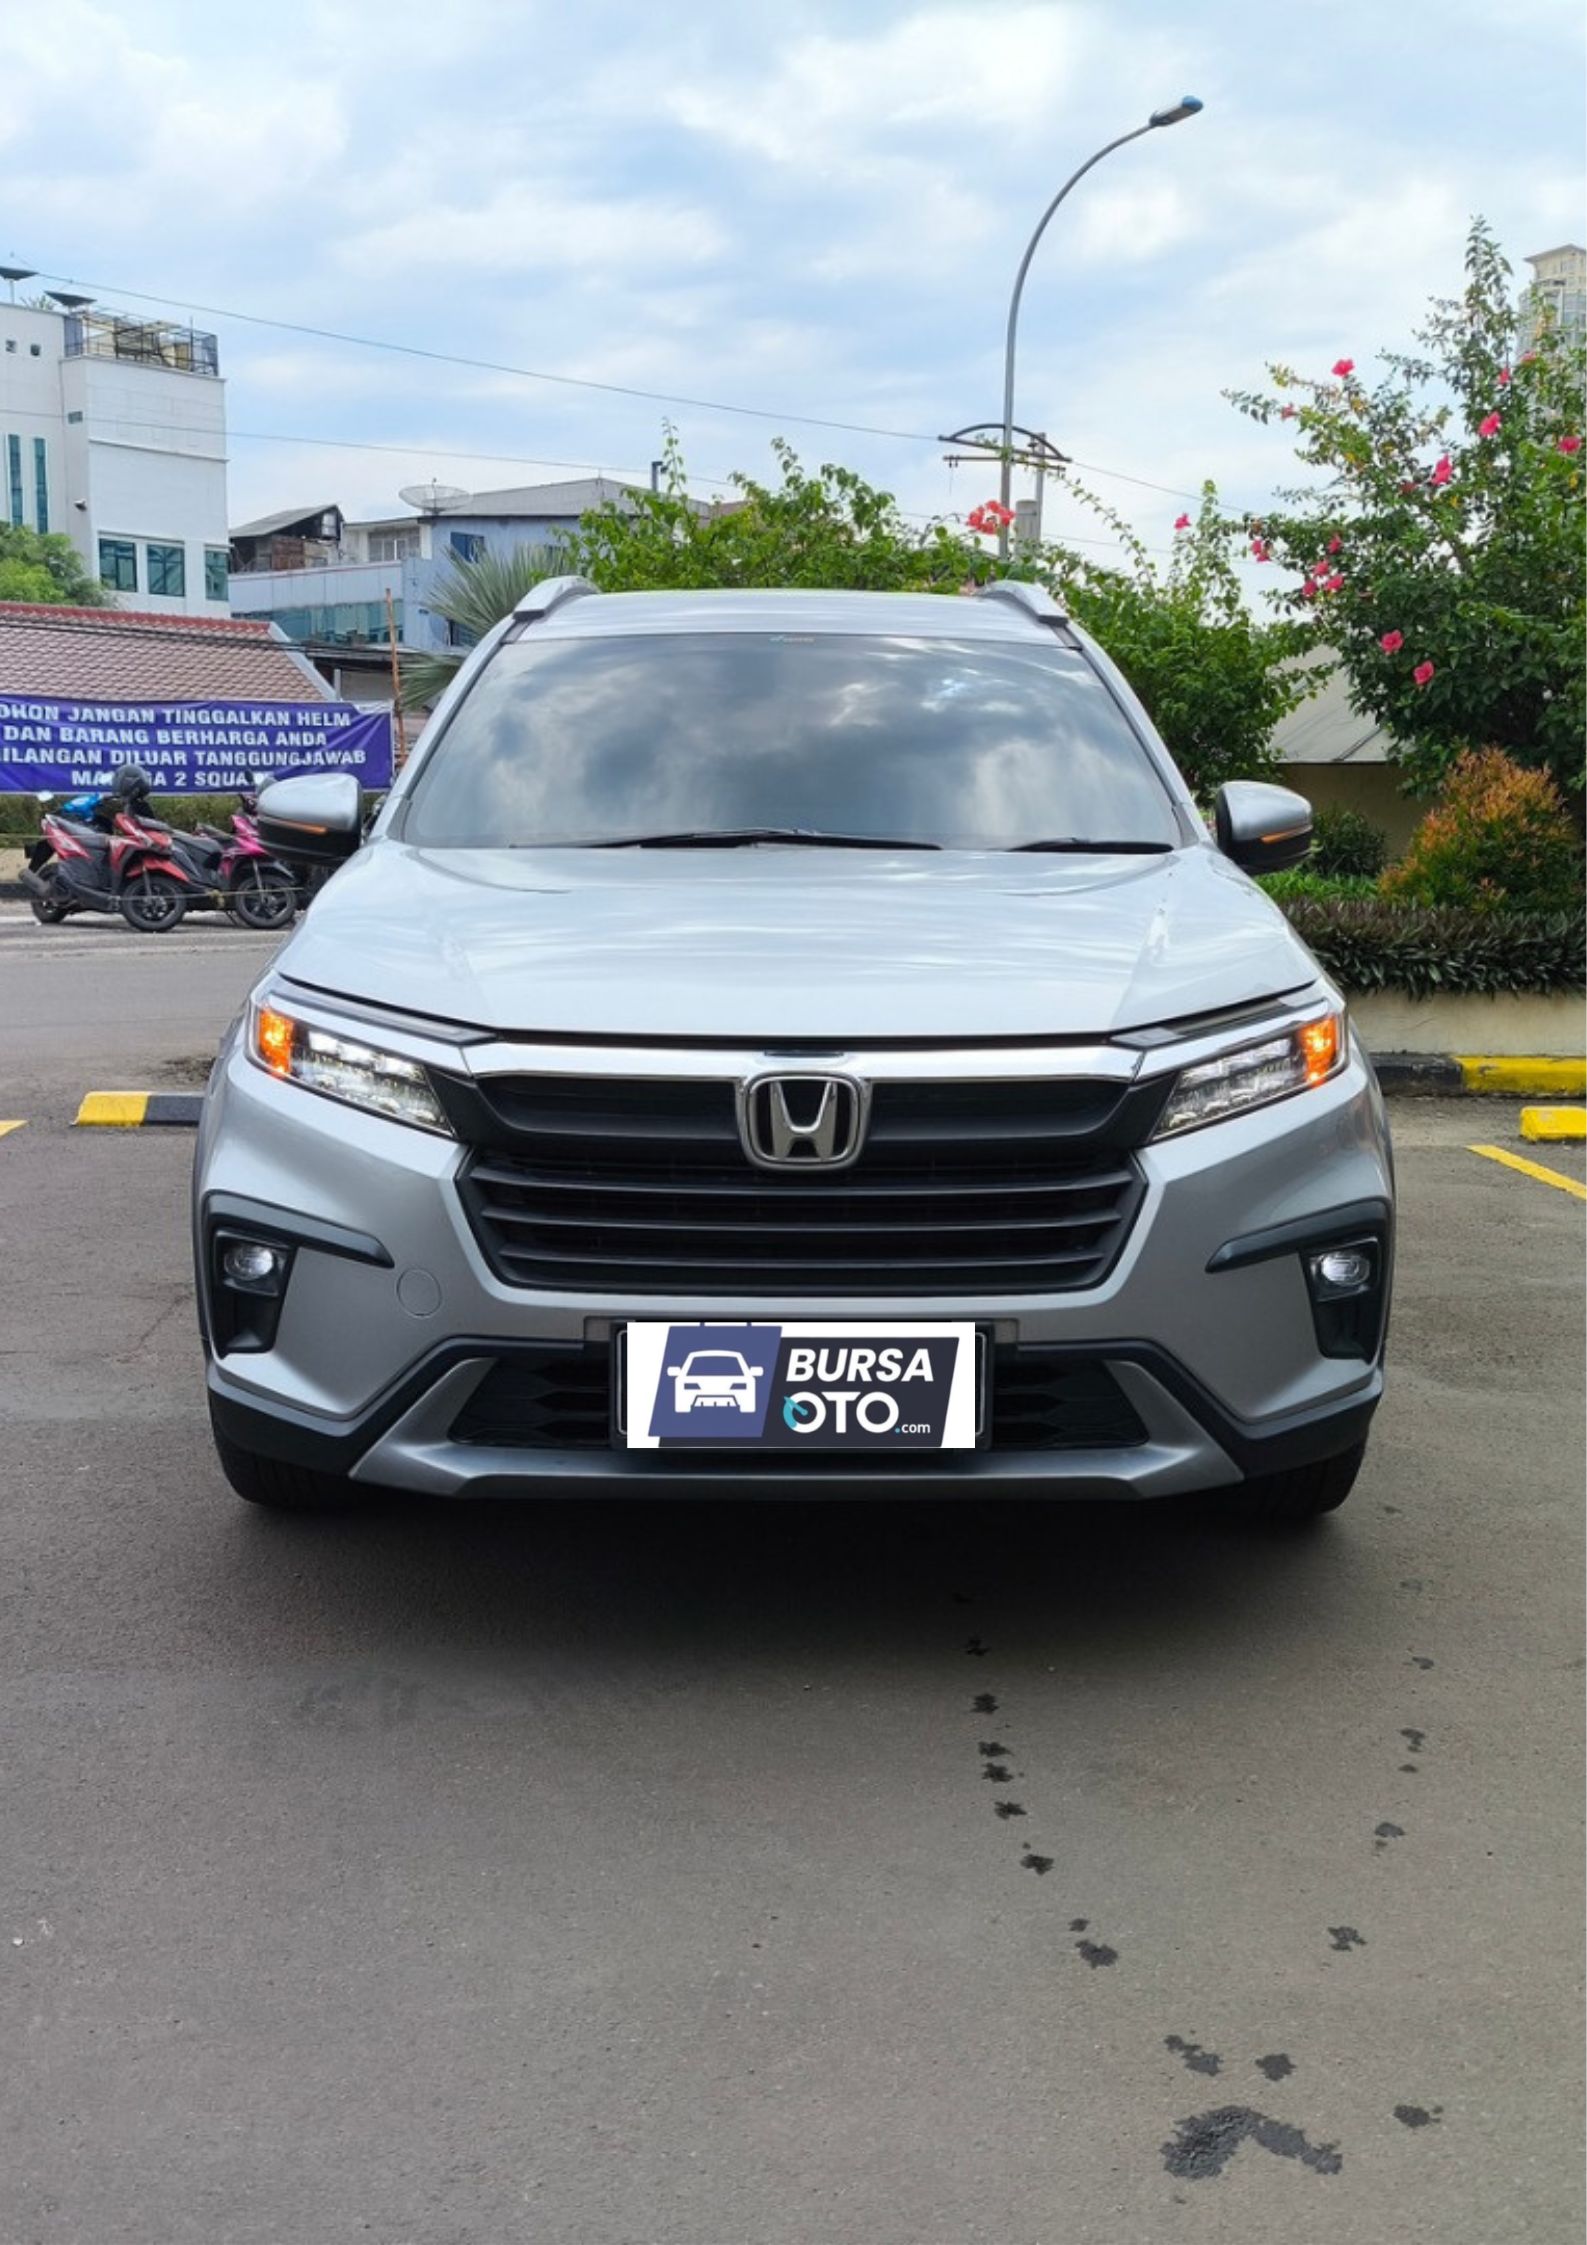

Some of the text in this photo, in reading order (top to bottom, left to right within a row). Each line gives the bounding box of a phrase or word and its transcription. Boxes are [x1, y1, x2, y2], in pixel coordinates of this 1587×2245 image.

[68, 708, 155, 723] JANGAN
[162, 710, 290, 725] TINGGALKAN
[297, 713, 350, 726] HELM
[3, 725, 327, 746] DAN BARANG BERHARGA ANDA
[0, 748, 366, 766] ILANGAN DILUAR TANGGUNGJAWAB
[174, 771, 187, 786] 2
